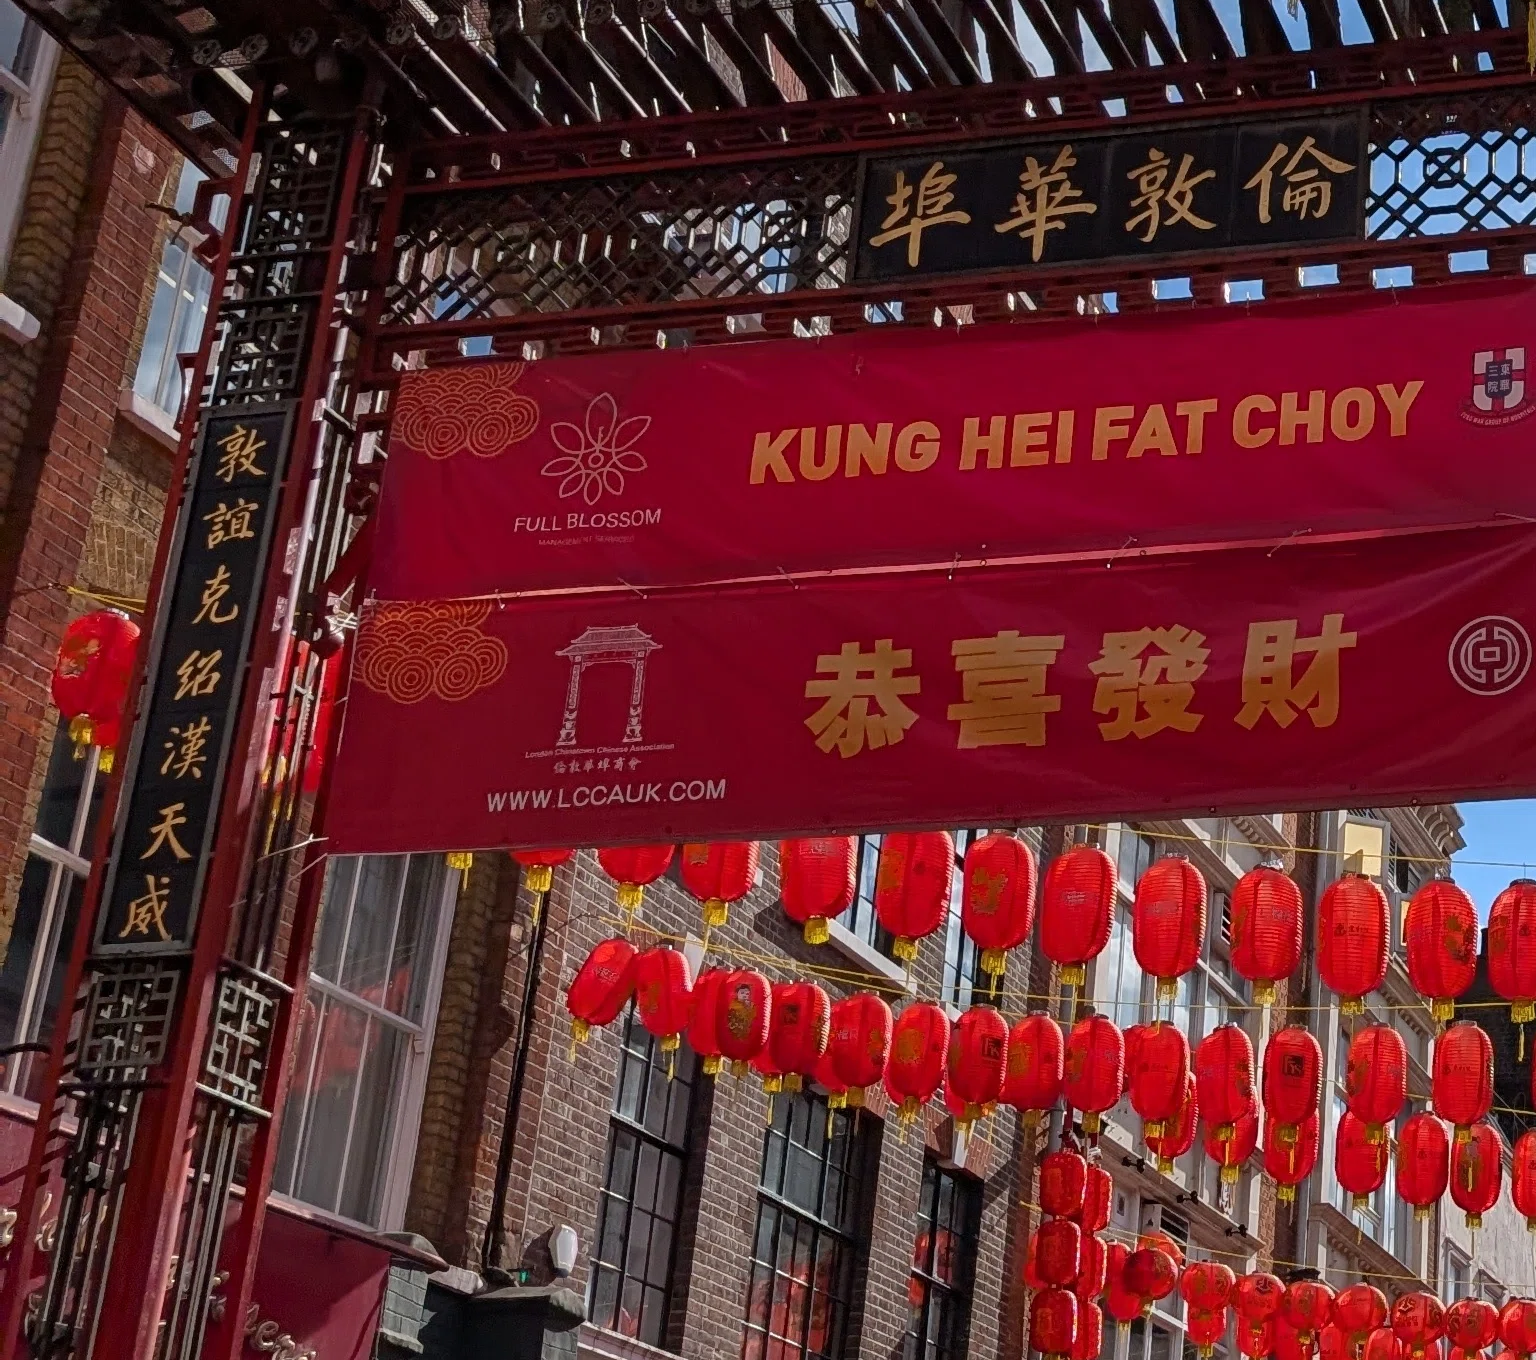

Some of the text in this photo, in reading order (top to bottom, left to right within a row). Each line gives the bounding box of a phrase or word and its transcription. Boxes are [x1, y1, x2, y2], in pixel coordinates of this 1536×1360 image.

[748, 379, 1427, 486] KUNG HEI FAT CHOY
[513, 508, 662, 533] FULL BLOSSOM
[803, 612, 1358, 760] 恭喜發財
[486, 778, 727, 813] WWW.LCCAUK.COM
